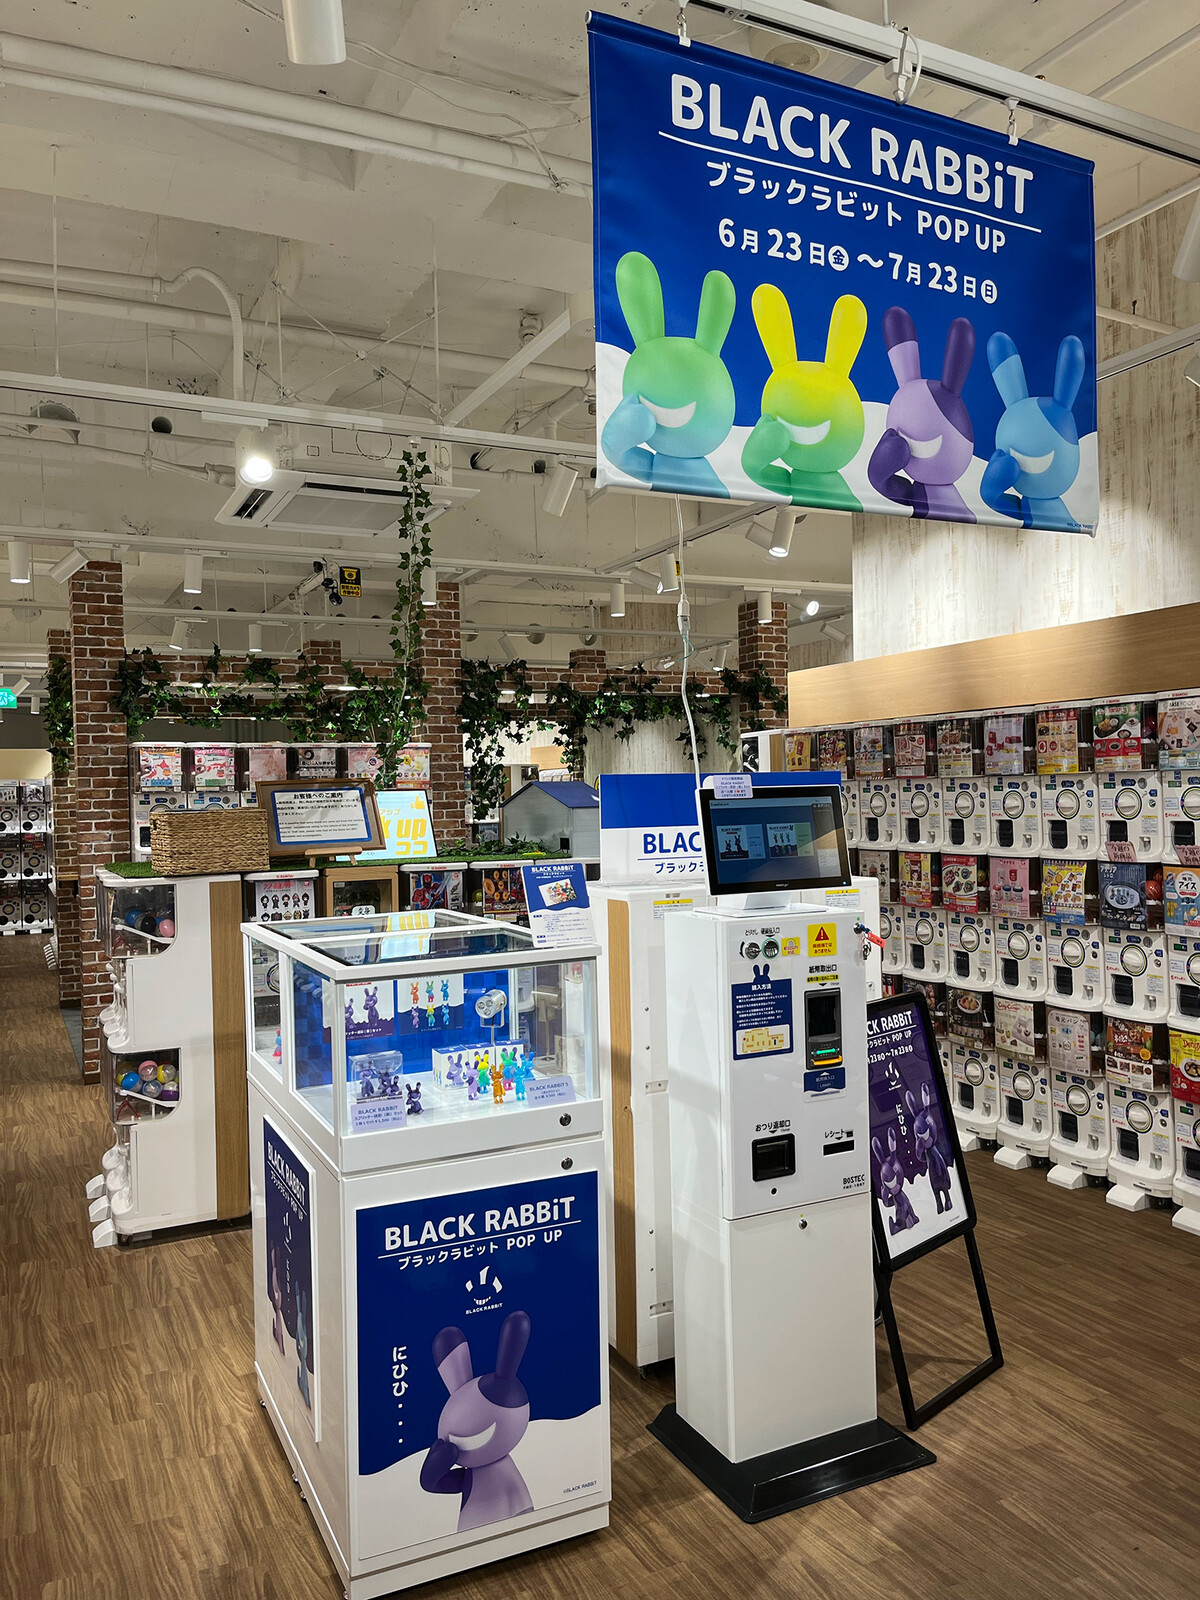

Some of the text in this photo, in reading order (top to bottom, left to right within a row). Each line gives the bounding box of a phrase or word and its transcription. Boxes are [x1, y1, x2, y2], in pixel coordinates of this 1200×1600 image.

[671, 73, 1034, 214] BLACK RABBiT
[706, 160, 1006, 253] ブラックラビット POP UP
[396, 818, 427, 841] up
[395, 840, 428, 856] ココ
[1178, 881, 1197, 890] アイス
[880, 1010, 913, 1032] RABBiT
[891, 1032, 903, 1042] POP
[903, 1029, 912, 1038] UP
[755, 1119, 791, 1132] おつり返却口
[824, 1128, 845, 1139] レシート
[267, 1141, 285, 1181] BLACK
[842, 1174, 866, 1185] BOSTEC
[385, 1196, 575, 1251] BLACK RABBiT
[398, 1229, 562, 1270] ブラックラビット POP UP
[465, 1307, 483, 1315] BLACK
